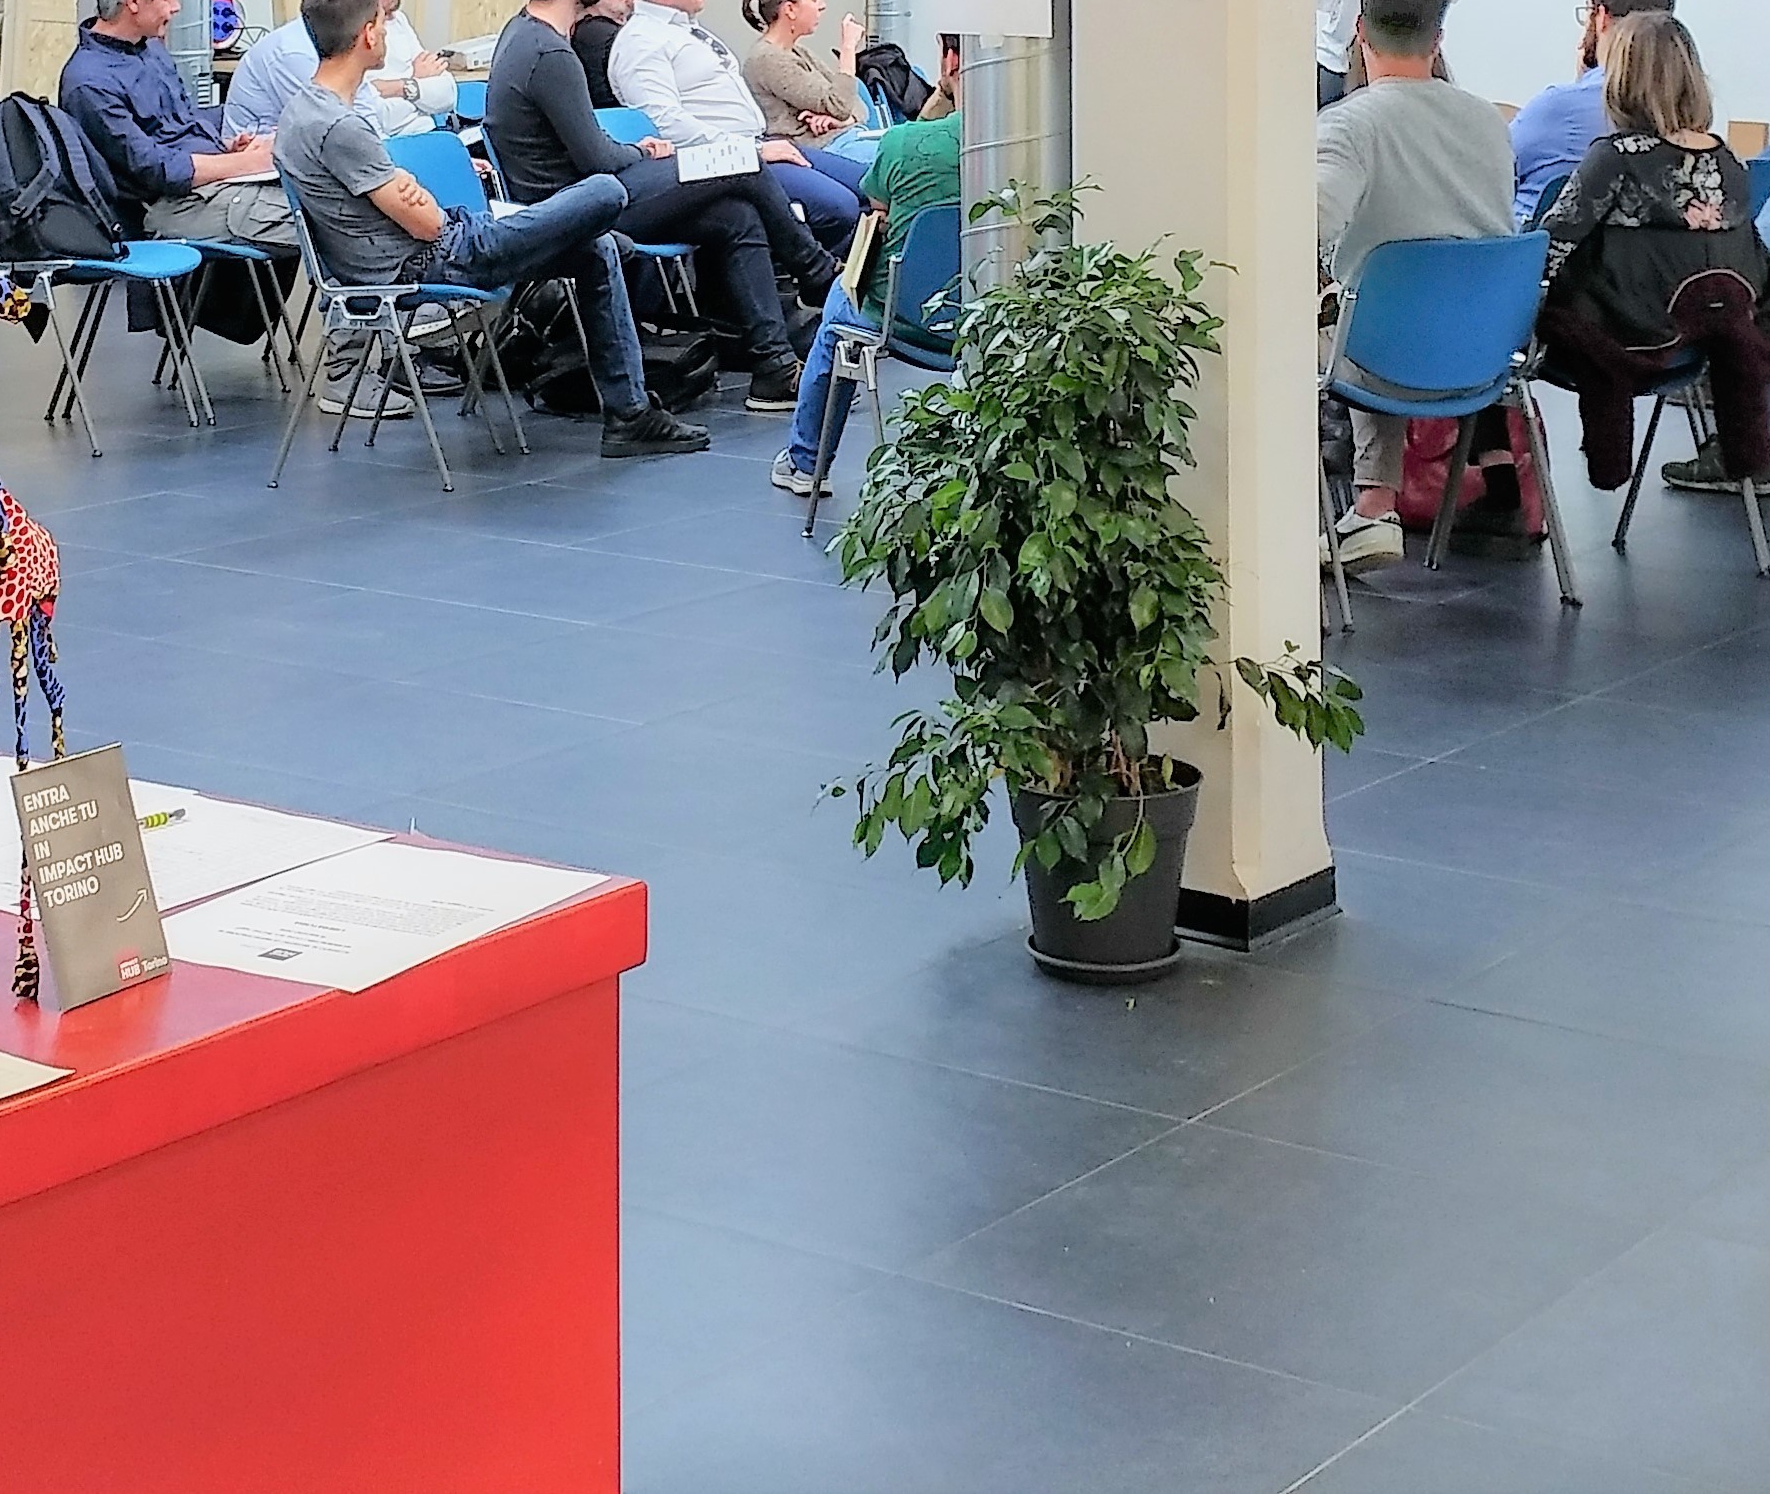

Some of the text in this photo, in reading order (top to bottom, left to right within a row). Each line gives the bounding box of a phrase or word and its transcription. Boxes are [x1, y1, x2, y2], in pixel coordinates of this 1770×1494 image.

[23, 784, 71, 813] ENTRA
[29, 800, 99, 837] ANCHE TU
[33, 840, 52, 861] IN
[38, 842, 125, 885] IMPACT HUB
[43, 876, 101, 908] TORINO
[121, 962, 141, 981] HUB
